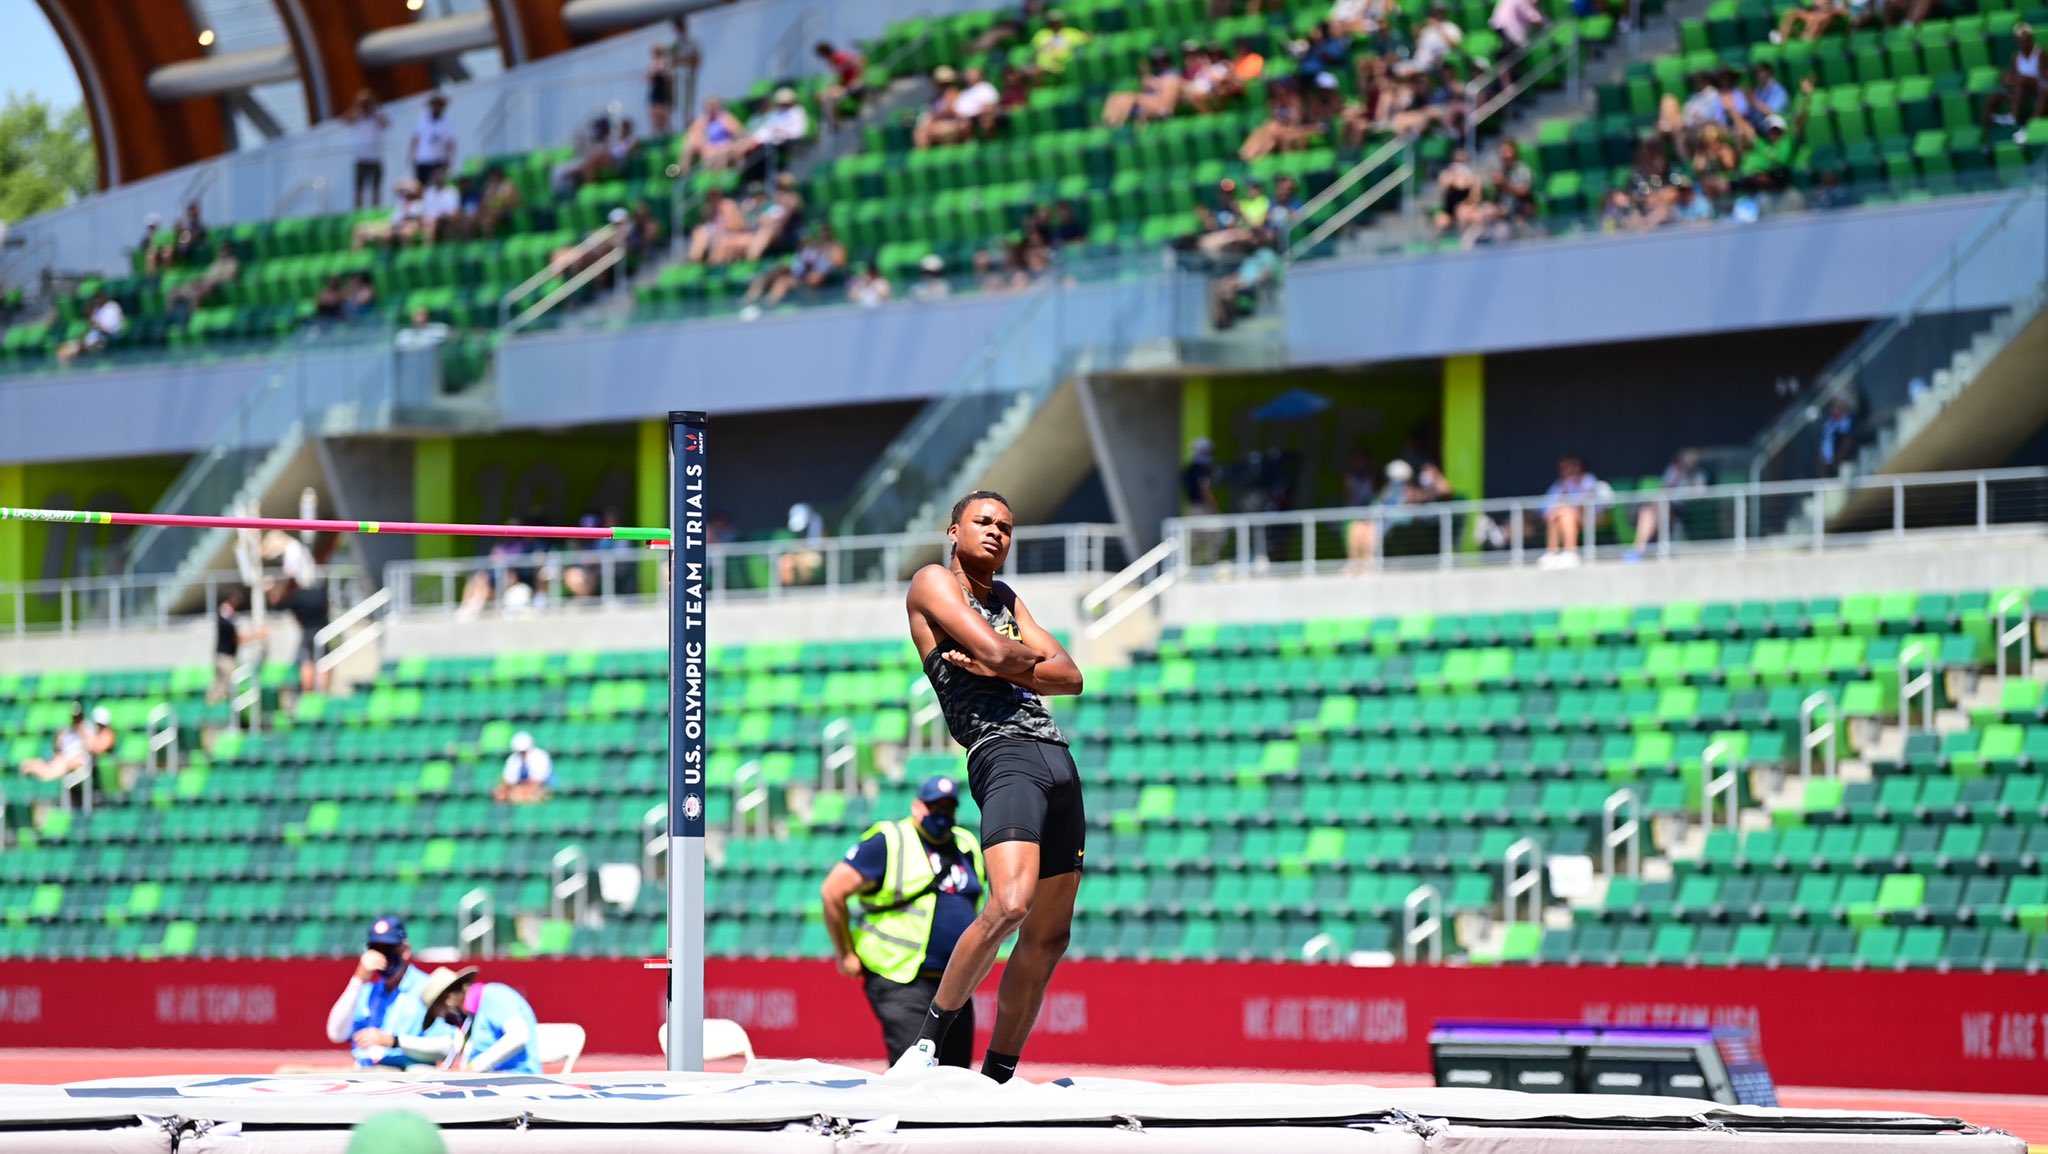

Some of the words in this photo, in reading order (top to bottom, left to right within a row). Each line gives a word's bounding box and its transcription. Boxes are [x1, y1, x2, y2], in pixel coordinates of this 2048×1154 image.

[686, 464, 702, 549] TRIALS
[686, 563, 703, 630] TEAM
[685, 641, 702, 739] OLYMPIC
[685, 744, 701, 785] U.S.
[1305, 997, 1361, 1041] TEAM
[1364, 998, 1407, 1043] USA
[1961, 1011, 1993, 1058] WE
[1997, 1012, 2037, 1060] ARE
